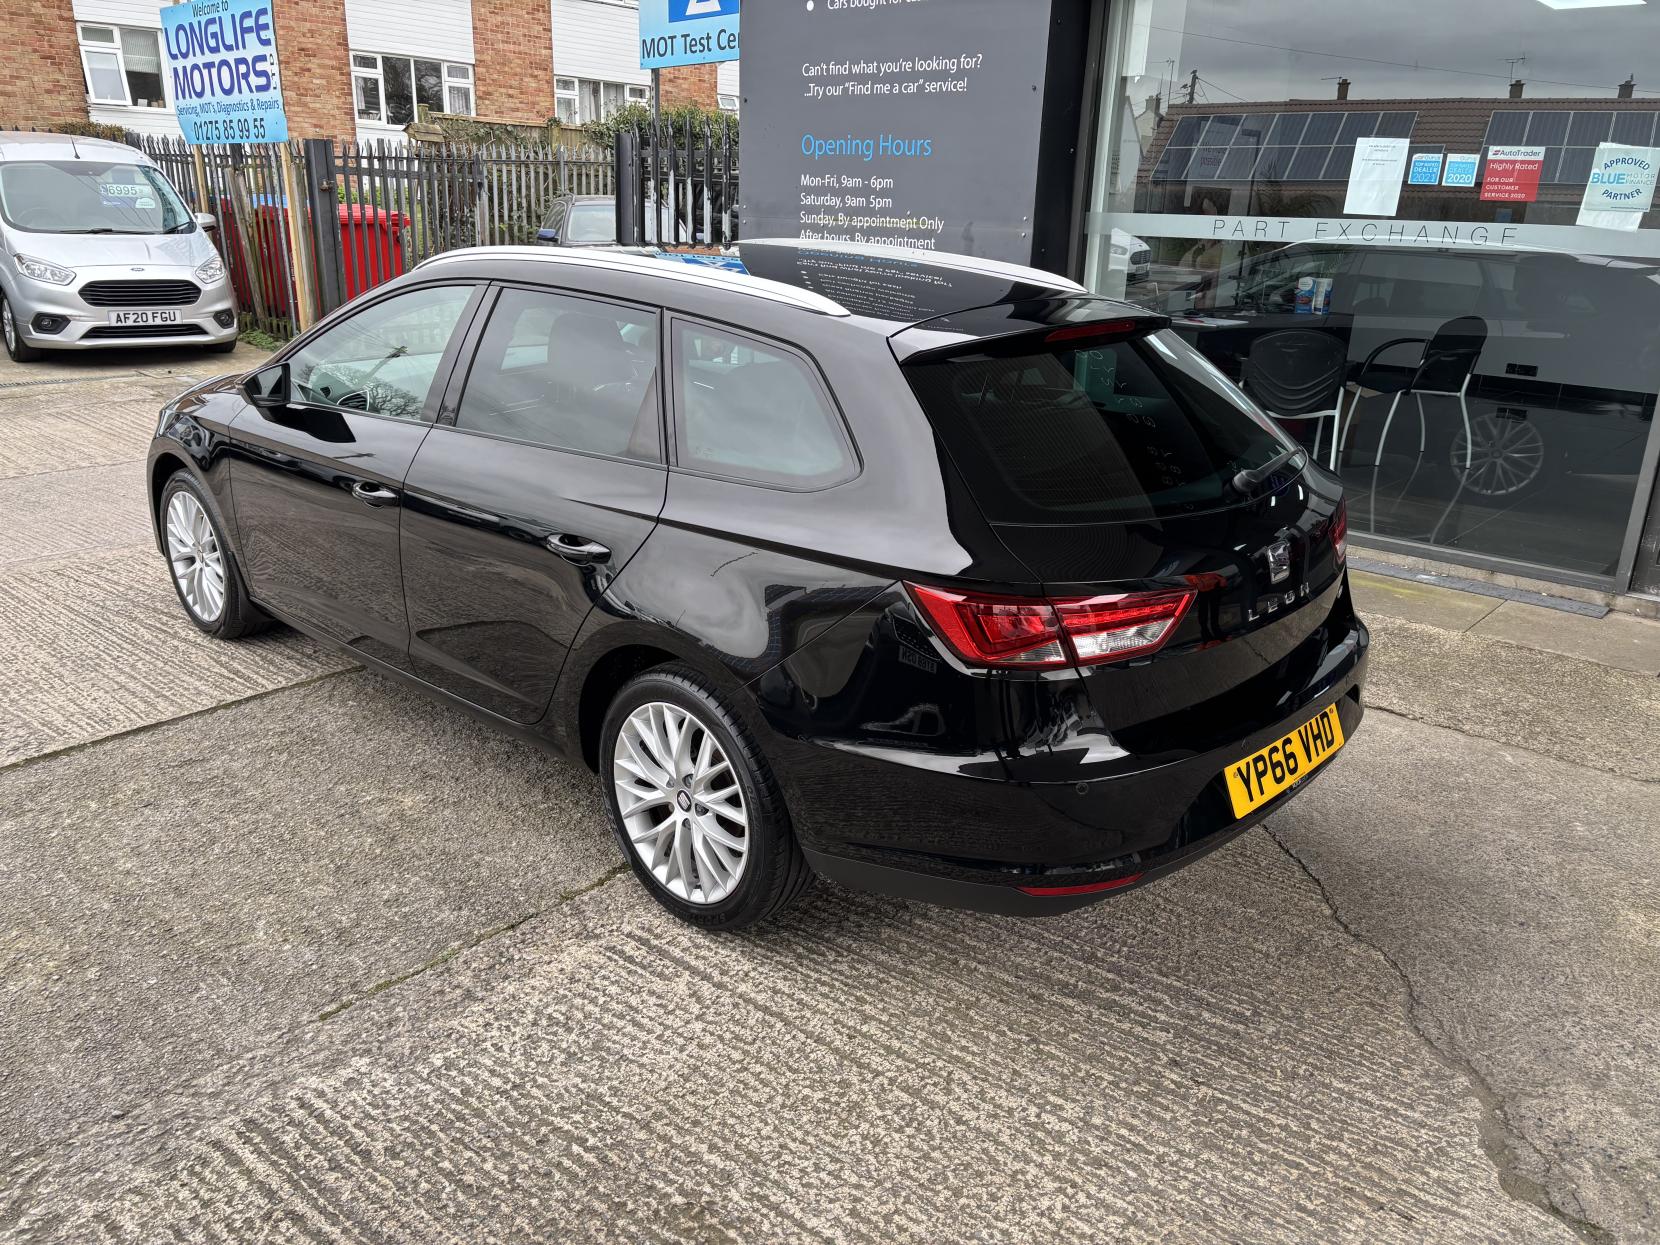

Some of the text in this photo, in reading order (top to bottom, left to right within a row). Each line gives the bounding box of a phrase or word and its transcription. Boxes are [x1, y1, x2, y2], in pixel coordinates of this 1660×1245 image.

[192, 0, 228, 17] Welcome to
[164, 7, 272, 60] LONGLIFE
[642, 34, 677, 59] MOT
[681, 32, 712, 55] Test
[802, 54, 983, 77] Can't find what you're looking for?
[172, 54, 271, 100] MOTORS
[826, 84, 843, 96] our
[845, 81, 871, 95] "Find
[873, 83, 891, 94] me
[893, 83, 899, 94] a
[901, 79, 924, 93] car"
[924, 77, 968, 93] service!
[217, 100, 250, 115] Diagnostics
[251, 99, 256, 111] &
[194, 118, 266, 141] 01275 85 99 55
[801, 133, 932, 161] Opening Hours
[1500, 149, 1541, 157] AutoTrader
[1490, 162, 1514, 170] Highly
[1604, 157, 1650, 171] APPROVED
[801, 174, 839, 188] Mon-Fri,
[841, 175, 862, 188] 9am
[870, 176, 894, 191] 6pm
[1447, 174, 1472, 182] 2020
[1590, 172, 1626, 184] BLUE
[800, 193, 892, 210] Saturday, 9am 5pm
[1602, 188, 1643, 200] PARTNER
[800, 211, 945, 233] Sunday, By appointment Only
[800, 229, 823, 240] After
[1212, 219, 1518, 246] PART EXCHANGE
[115, 311, 177, 324] AF20 FGU
[1237, 710, 1335, 803] YP66 VHD
